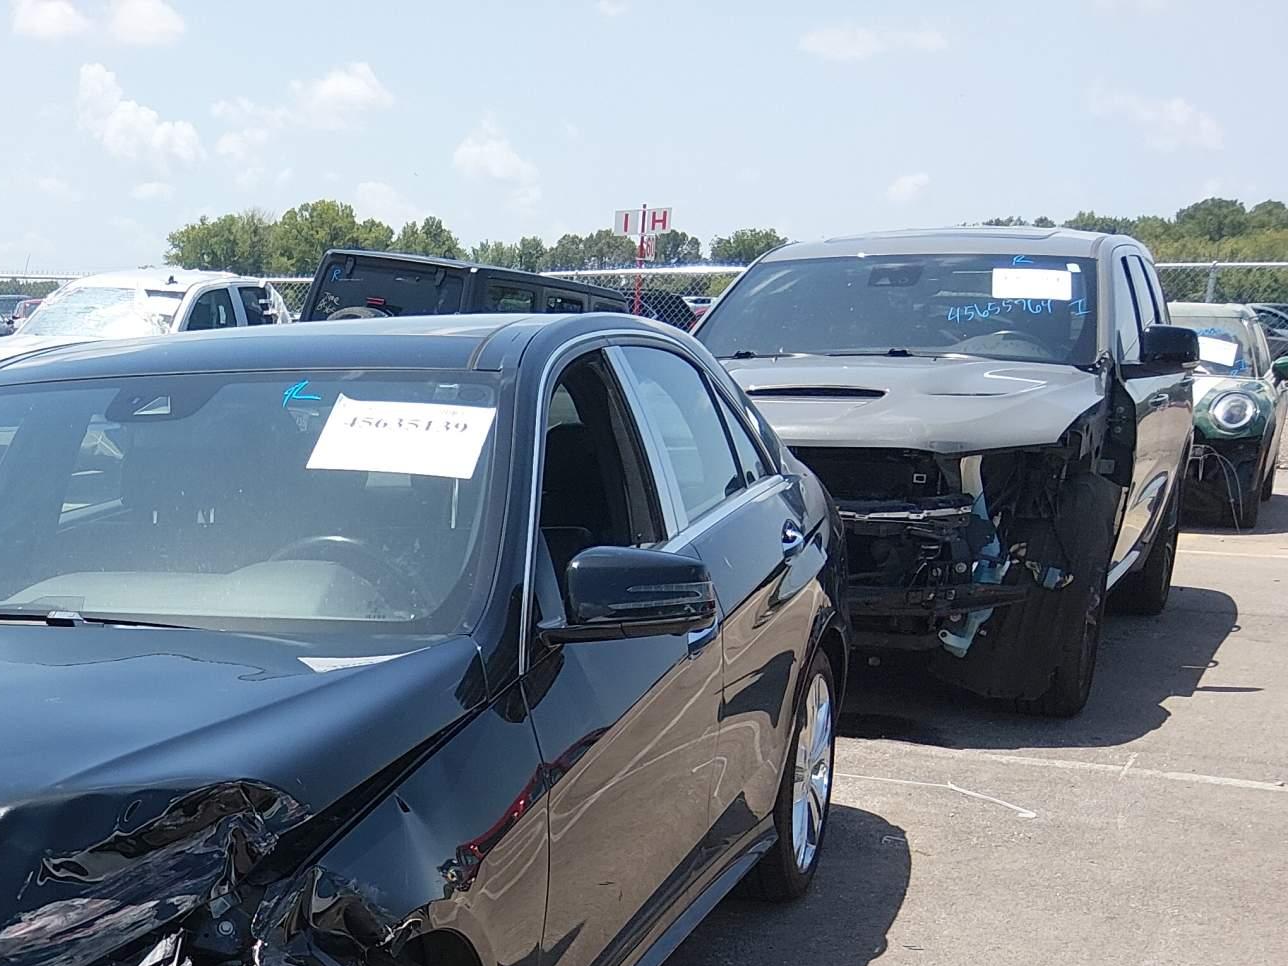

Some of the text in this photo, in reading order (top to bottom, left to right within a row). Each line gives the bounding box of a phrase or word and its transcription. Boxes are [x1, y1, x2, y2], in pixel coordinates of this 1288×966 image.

[651, 210, 667, 230] H
[331, 269, 341, 281] R
[344, 416, 468, 433] 45635139
